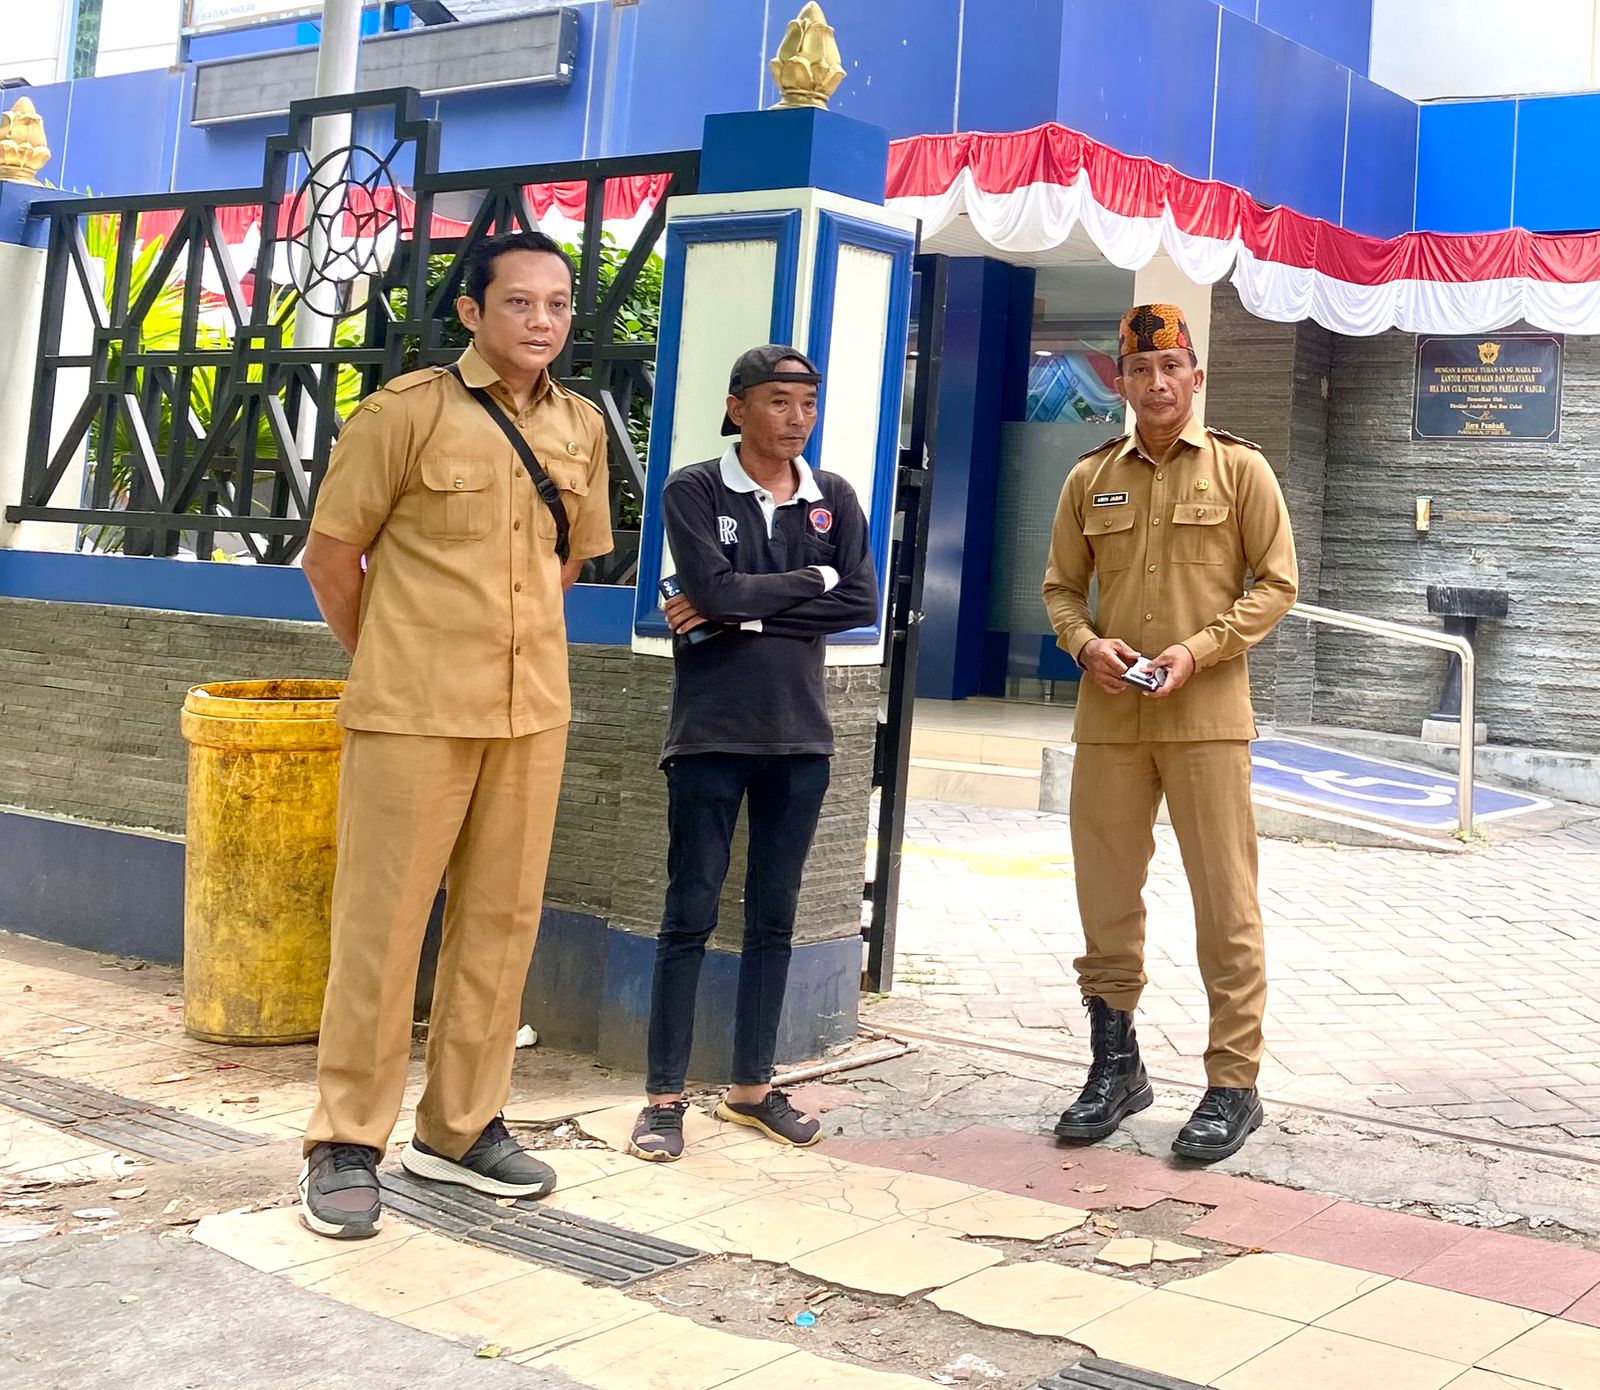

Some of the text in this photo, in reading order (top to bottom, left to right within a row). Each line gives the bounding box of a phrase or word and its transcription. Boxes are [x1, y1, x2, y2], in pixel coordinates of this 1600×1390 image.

[1441, 374, 1536, 383] KANTOR PENGAWASAN DAN PELAYANAN
[1429, 384, 1439, 393] BEA
[1440, 384, 1451, 393] DAN
[1451, 384, 1467, 393] CUKAI
[1525, 384, 1546, 393] MADURA
